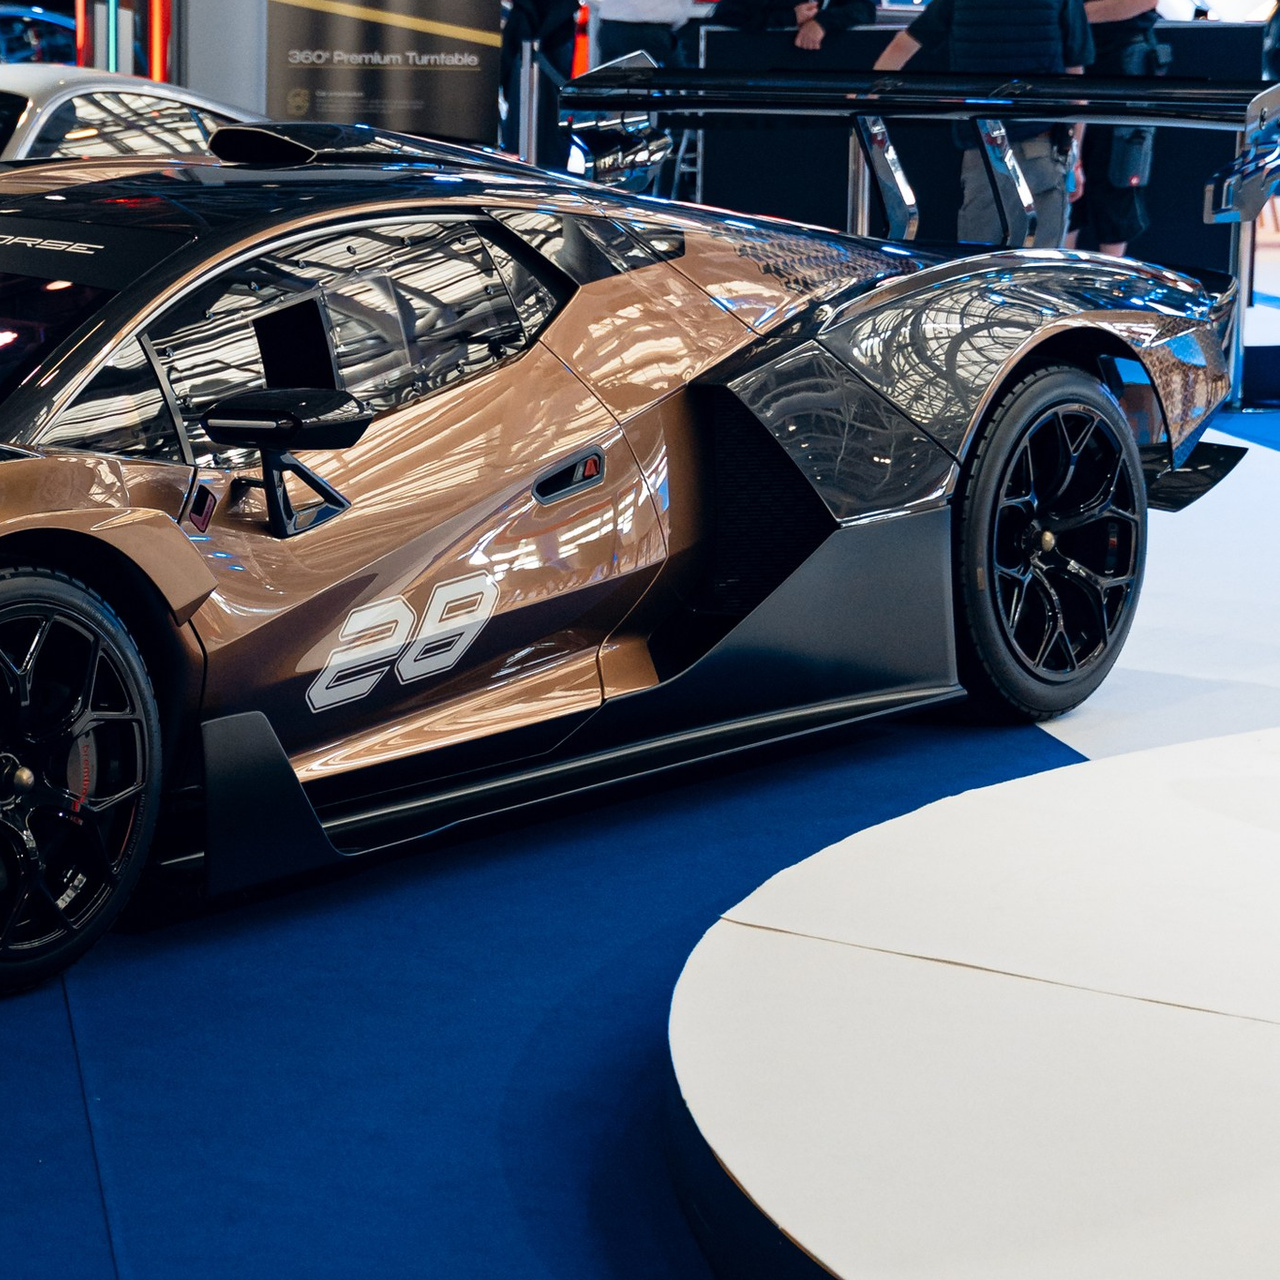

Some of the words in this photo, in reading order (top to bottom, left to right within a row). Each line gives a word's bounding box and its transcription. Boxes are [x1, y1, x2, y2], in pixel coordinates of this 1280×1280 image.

[332, 50, 403, 65] Premium
[404, 52, 479, 66] Turntable
[305, 570, 500, 714] 28
